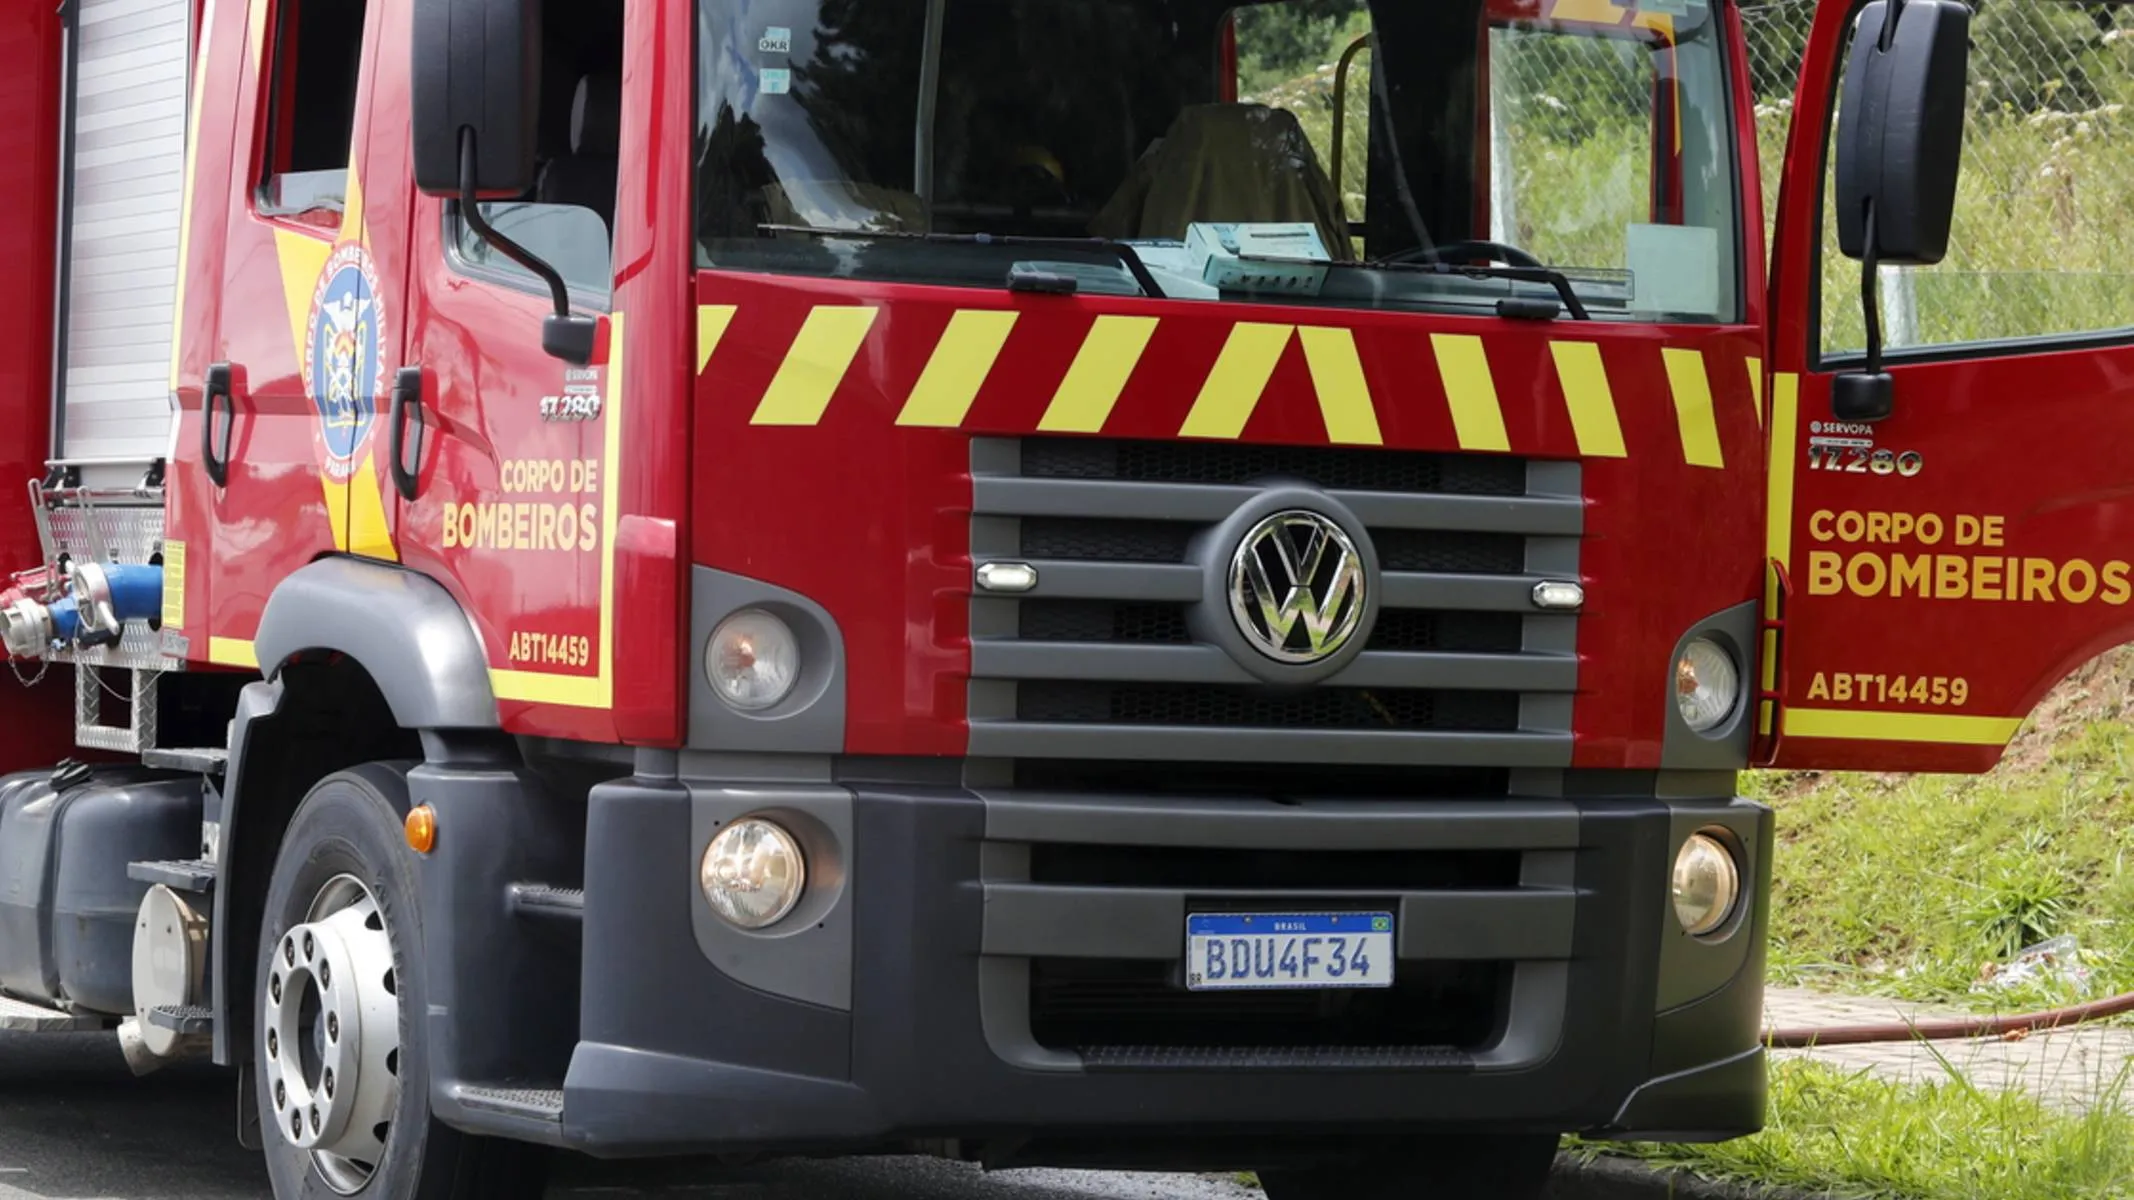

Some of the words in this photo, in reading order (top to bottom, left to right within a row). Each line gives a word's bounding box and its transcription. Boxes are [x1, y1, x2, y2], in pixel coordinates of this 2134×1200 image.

[305, 314, 317, 400] CORPO
[314, 276, 326, 306] DE
[373, 293, 386, 398] MILITAR
[1823, 422, 1873, 435] SERVOPA
[501, 460, 565, 492] CORPO
[570, 460, 597, 493] DE
[1808, 444, 1923, 477] 17.280
[442, 503, 597, 551] BOMBEIROS
[1809, 509, 1944, 545] CORPO
[1955, 514, 2005, 547] DE
[1808, 551, 2132, 605] BOMBEIROS
[509, 632, 589, 667] ABT14459
[1807, 672, 1968, 705] ABT14459
[1274, 921, 1306, 931] BRASIL
[1206, 937, 1370, 979] BDU4F34
